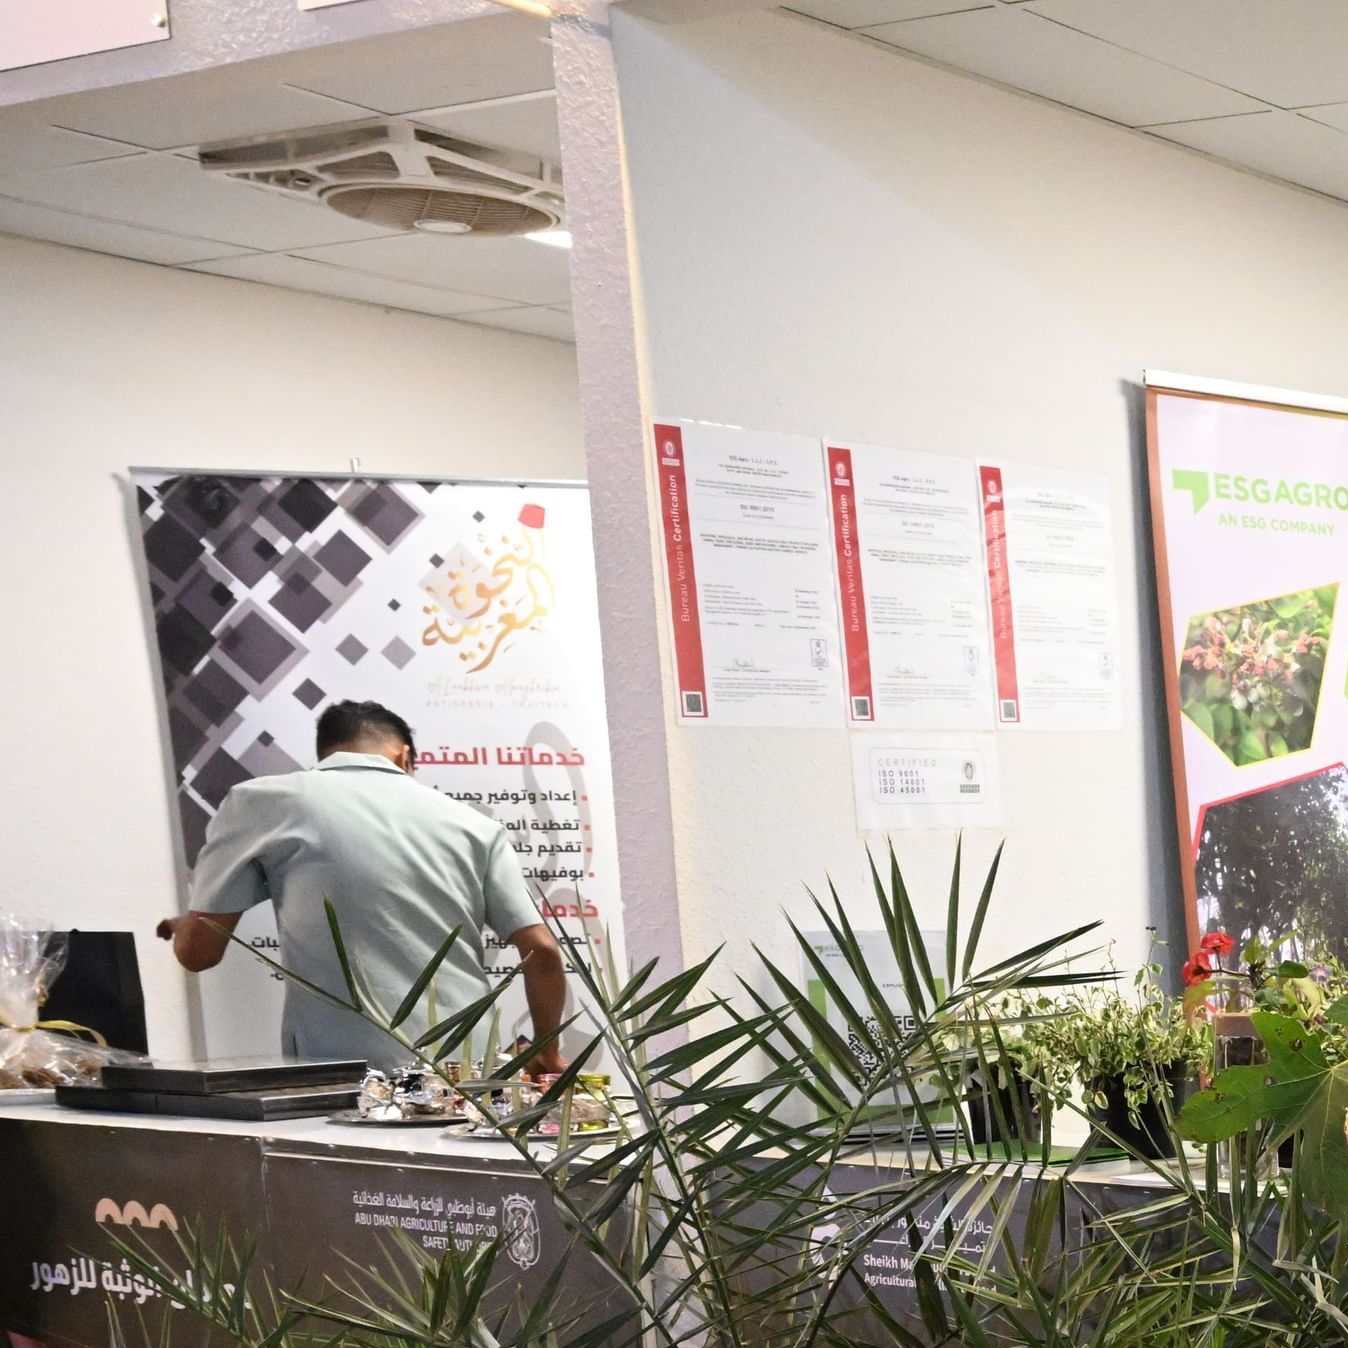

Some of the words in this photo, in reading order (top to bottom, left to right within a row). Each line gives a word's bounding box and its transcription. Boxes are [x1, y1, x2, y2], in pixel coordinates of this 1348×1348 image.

[668, 474, 682, 542] Certification
[840, 494, 852, 556] Certification
[1218, 513, 1237, 527] AN
[1241, 515, 1267, 530] ESG
[1270, 518, 1335, 537] COMPANY
[497, 747, 585, 766] خدماتنا
[878, 770, 895, 778] ISO
[878, 778, 896, 786] ISO
[487, 789, 537, 805] وتوفير
[540, 790, 577, 806] إعداد
[880, 786, 896, 794] ISO
[530, 819, 581, 833] تغطية
[537, 841, 582, 857] تقديم
[522, 867, 584, 881] بوفيهات
[354, 1212, 372, 1226] ABU
[455, 1221, 474, 1235] AND
[422, 1236, 450, 1251] SAFET
[863, 1253, 899, 1270] Sheikh
[30, 1256, 98, 1296] للزهور
